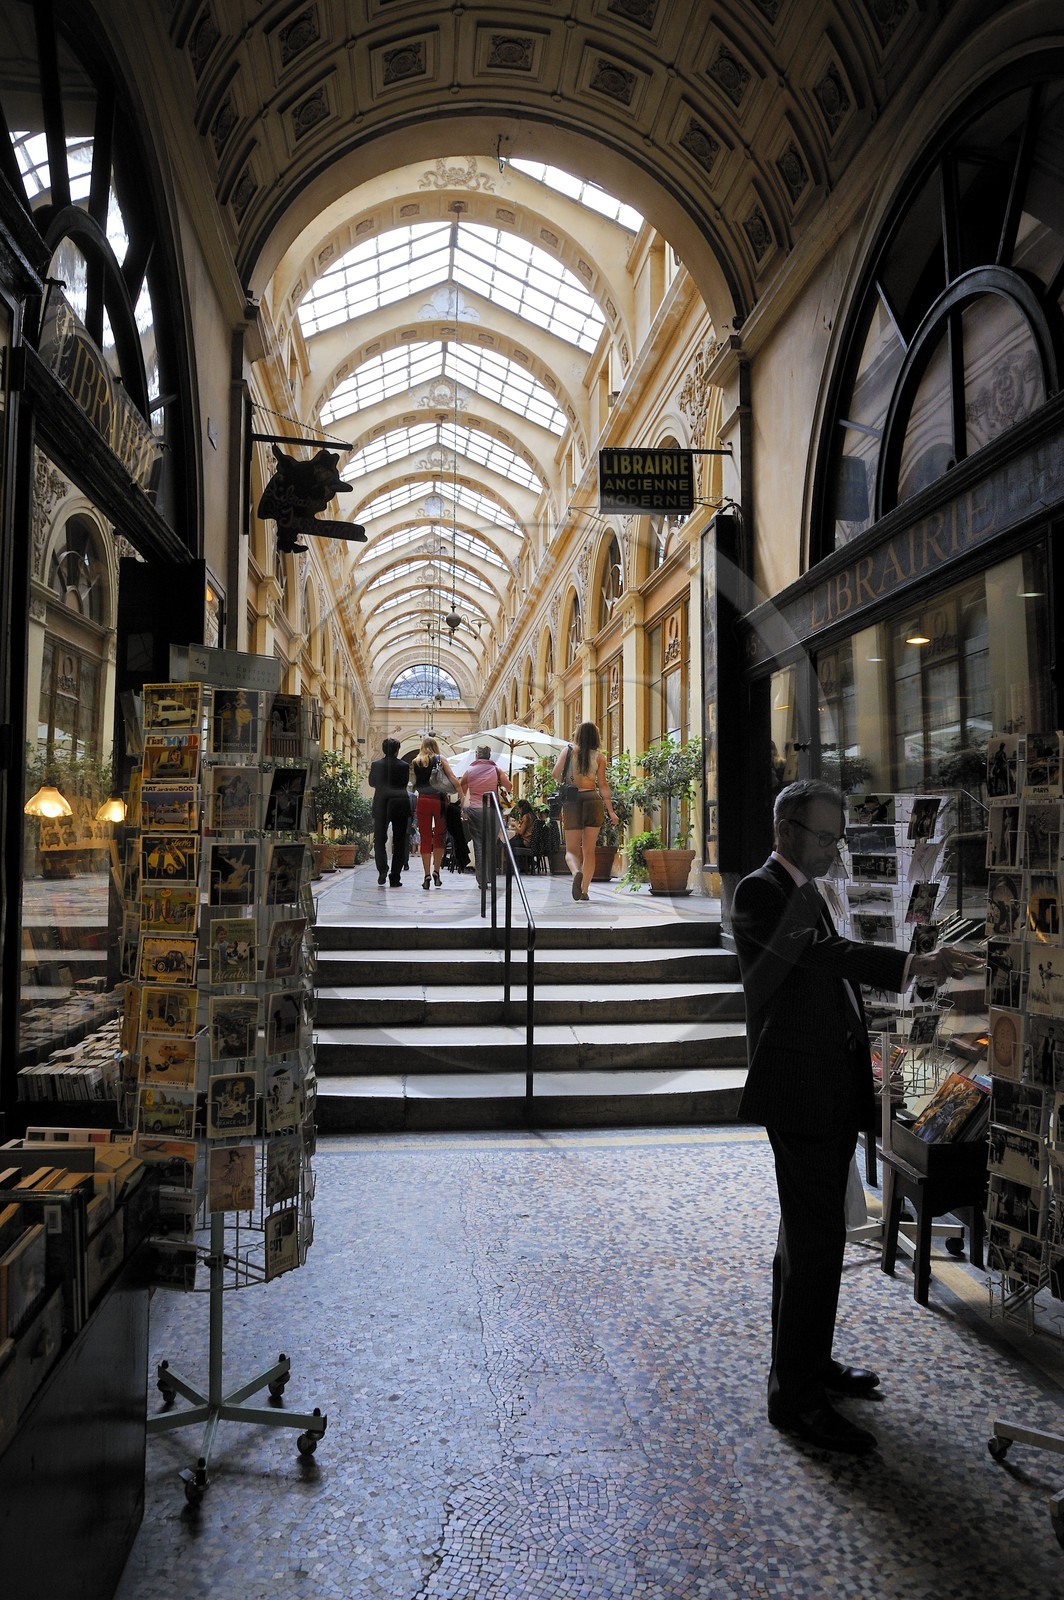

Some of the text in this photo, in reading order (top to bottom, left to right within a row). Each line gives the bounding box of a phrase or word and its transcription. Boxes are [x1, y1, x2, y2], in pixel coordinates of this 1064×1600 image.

[602, 454, 689, 475] LIBRAIRIE
[603, 478, 689, 491] ANCIENNE
[603, 494, 689, 507] MODERNE
[809, 478, 1000, 630] LIBRAIRIE
[269, 1238, 282, 1252] CUT
